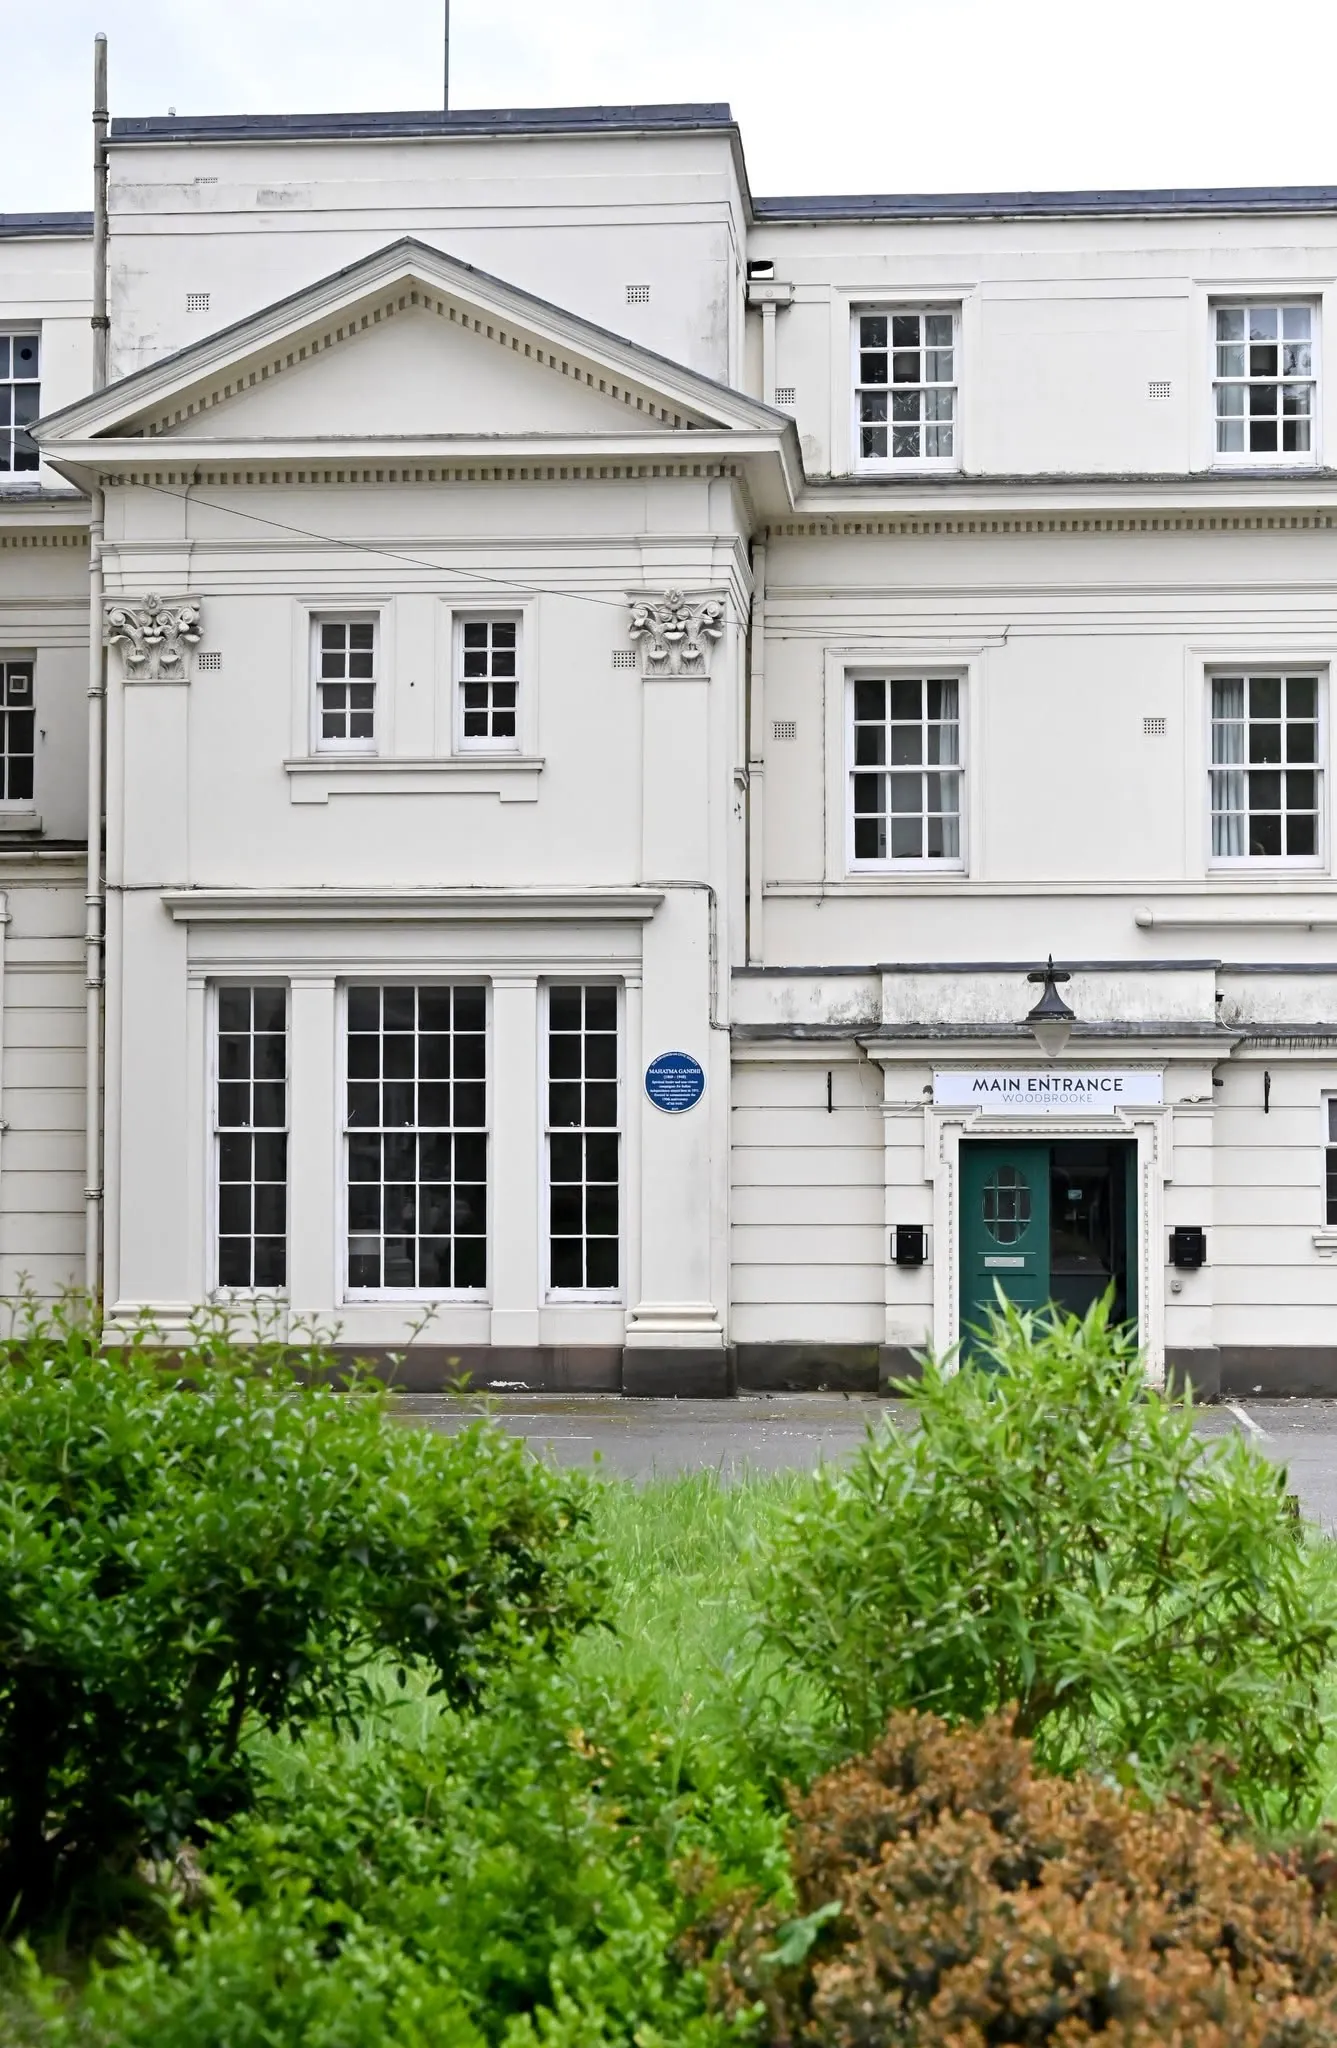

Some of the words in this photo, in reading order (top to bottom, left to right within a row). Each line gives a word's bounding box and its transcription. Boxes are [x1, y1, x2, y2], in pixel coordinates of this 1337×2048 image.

[972, 1078, 1020, 1092] MAIN
[1027, 1078, 1124, 1092] ENTRANCE
[1002, 1093, 1093, 1103] WOODBROOKE
